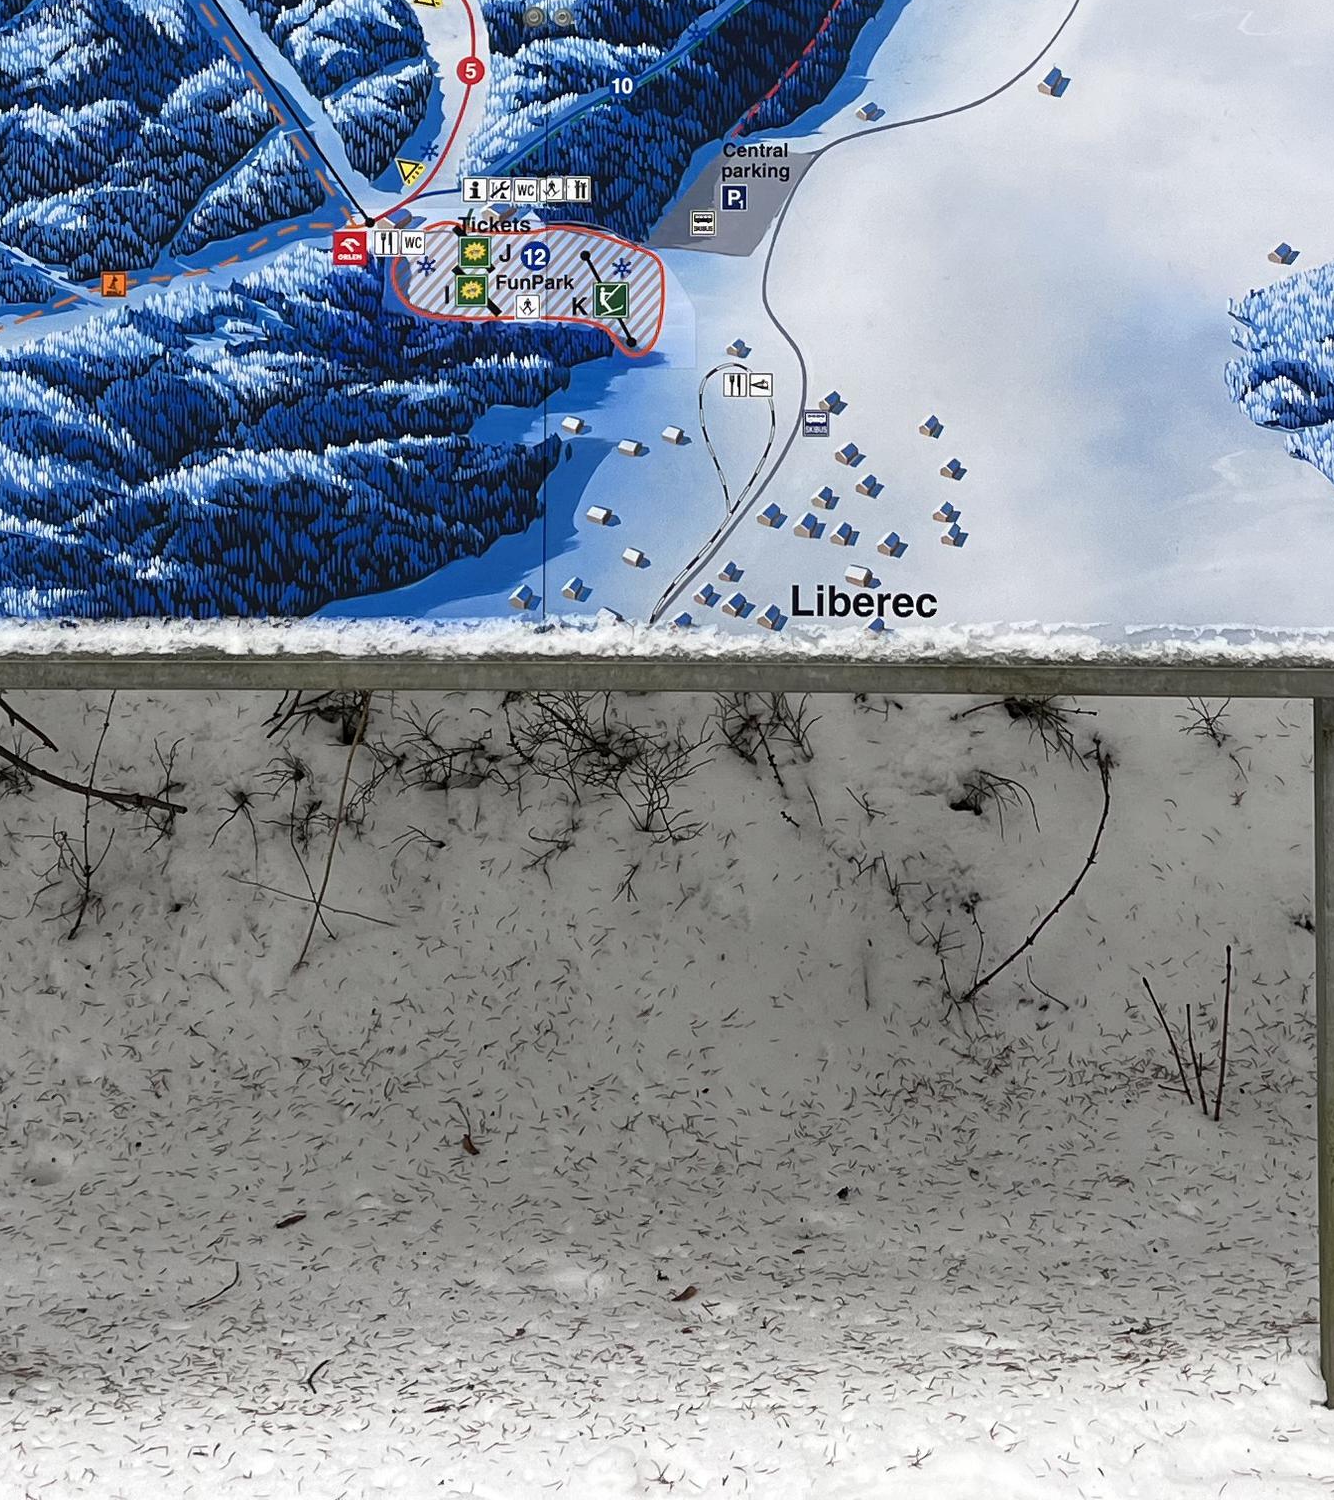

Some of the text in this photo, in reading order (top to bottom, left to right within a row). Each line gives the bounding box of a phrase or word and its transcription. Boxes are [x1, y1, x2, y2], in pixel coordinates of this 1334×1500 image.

[611, 77, 634, 95] 10
[723, 142, 788, 158] Central
[721, 162, 790, 183] parking
[457, 216, 531, 234] Tickets
[523, 248, 547, 266] 12
[495, 274, 575, 291] FunPark
[791, 584, 938, 619] Liberec
